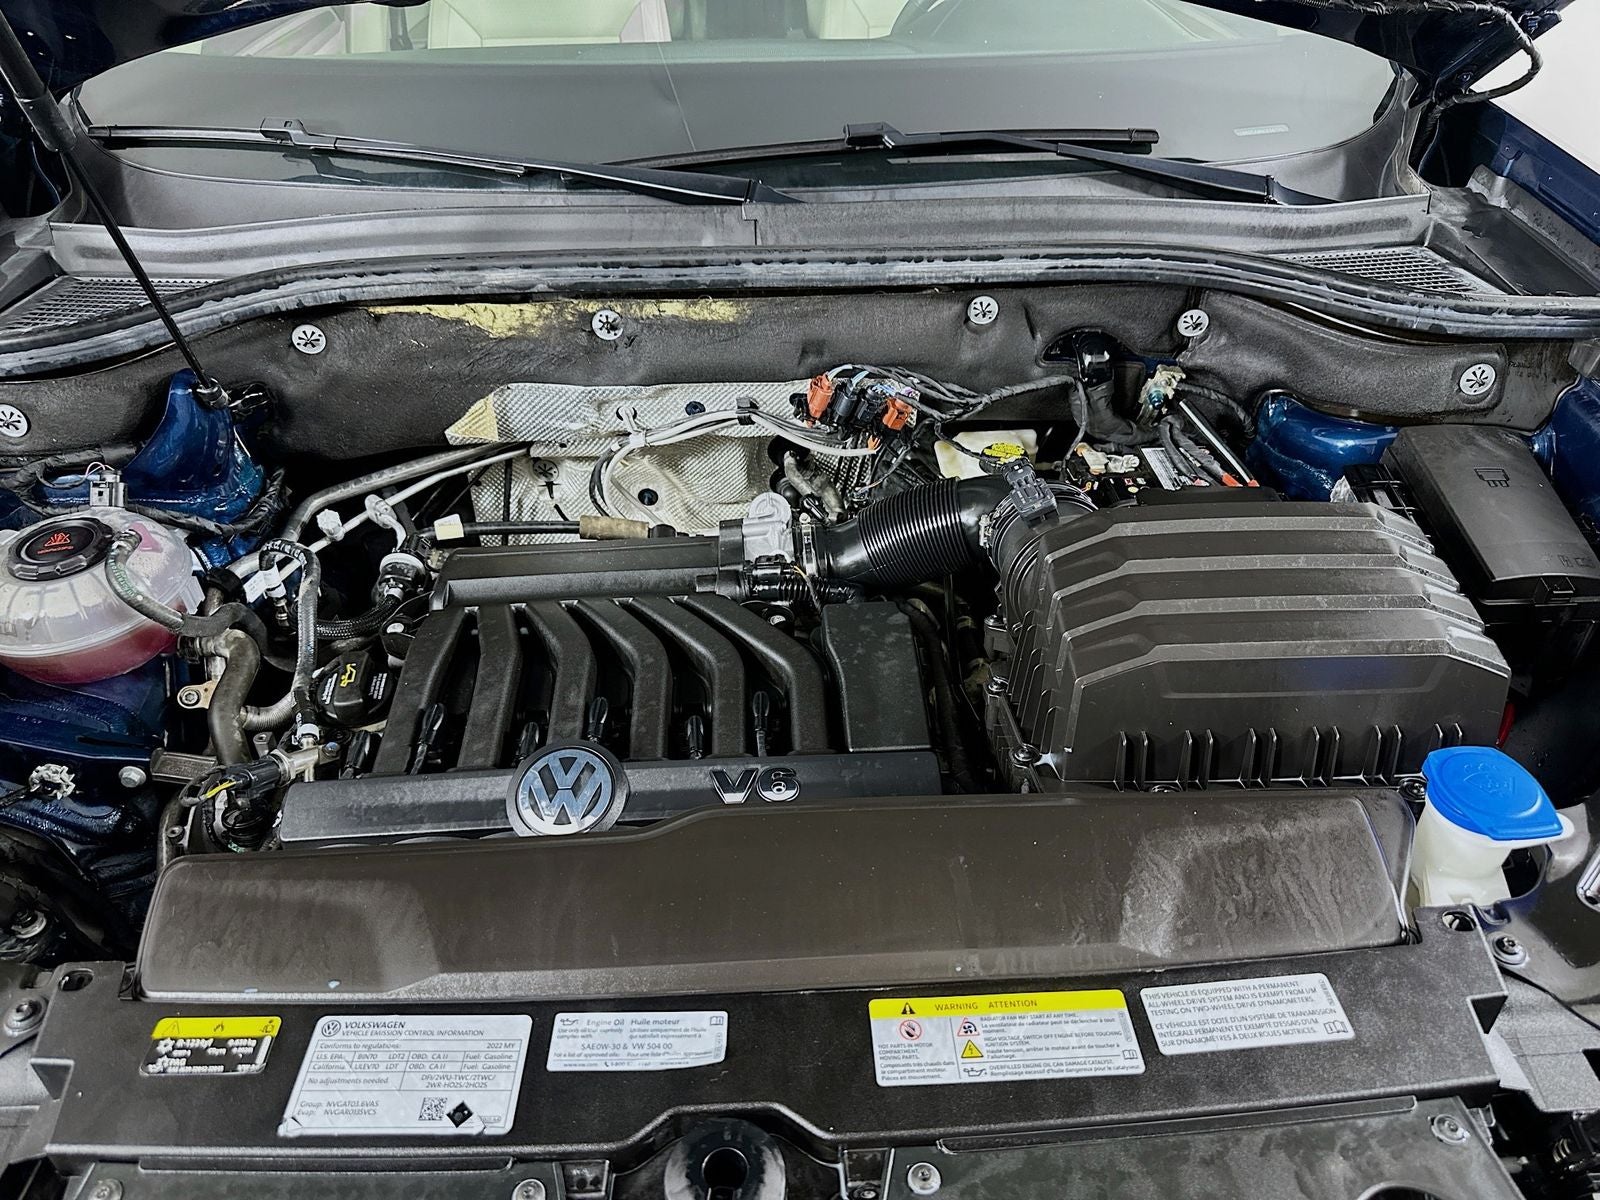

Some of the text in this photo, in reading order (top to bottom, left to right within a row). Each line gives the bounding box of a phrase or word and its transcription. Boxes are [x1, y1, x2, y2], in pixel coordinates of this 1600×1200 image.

[710, 767, 801, 804] V6
[1199, 987, 1232, 995] EQUIPPED
[1260, 982, 1299, 990] PERMANENT
[935, 1000, 1038, 1011] WARNING ATTENTION
[1149, 999, 1186, 1008] ALL-WHEEL
[1193, 1003, 1235, 1012] TWO-WHEEL
[1288, 1008, 1336, 1018] TRANSMISSION
[345, 1021, 406, 1029] VOLKSWAGEN
[1195, 1026, 1234, 1035] PERMANENT
